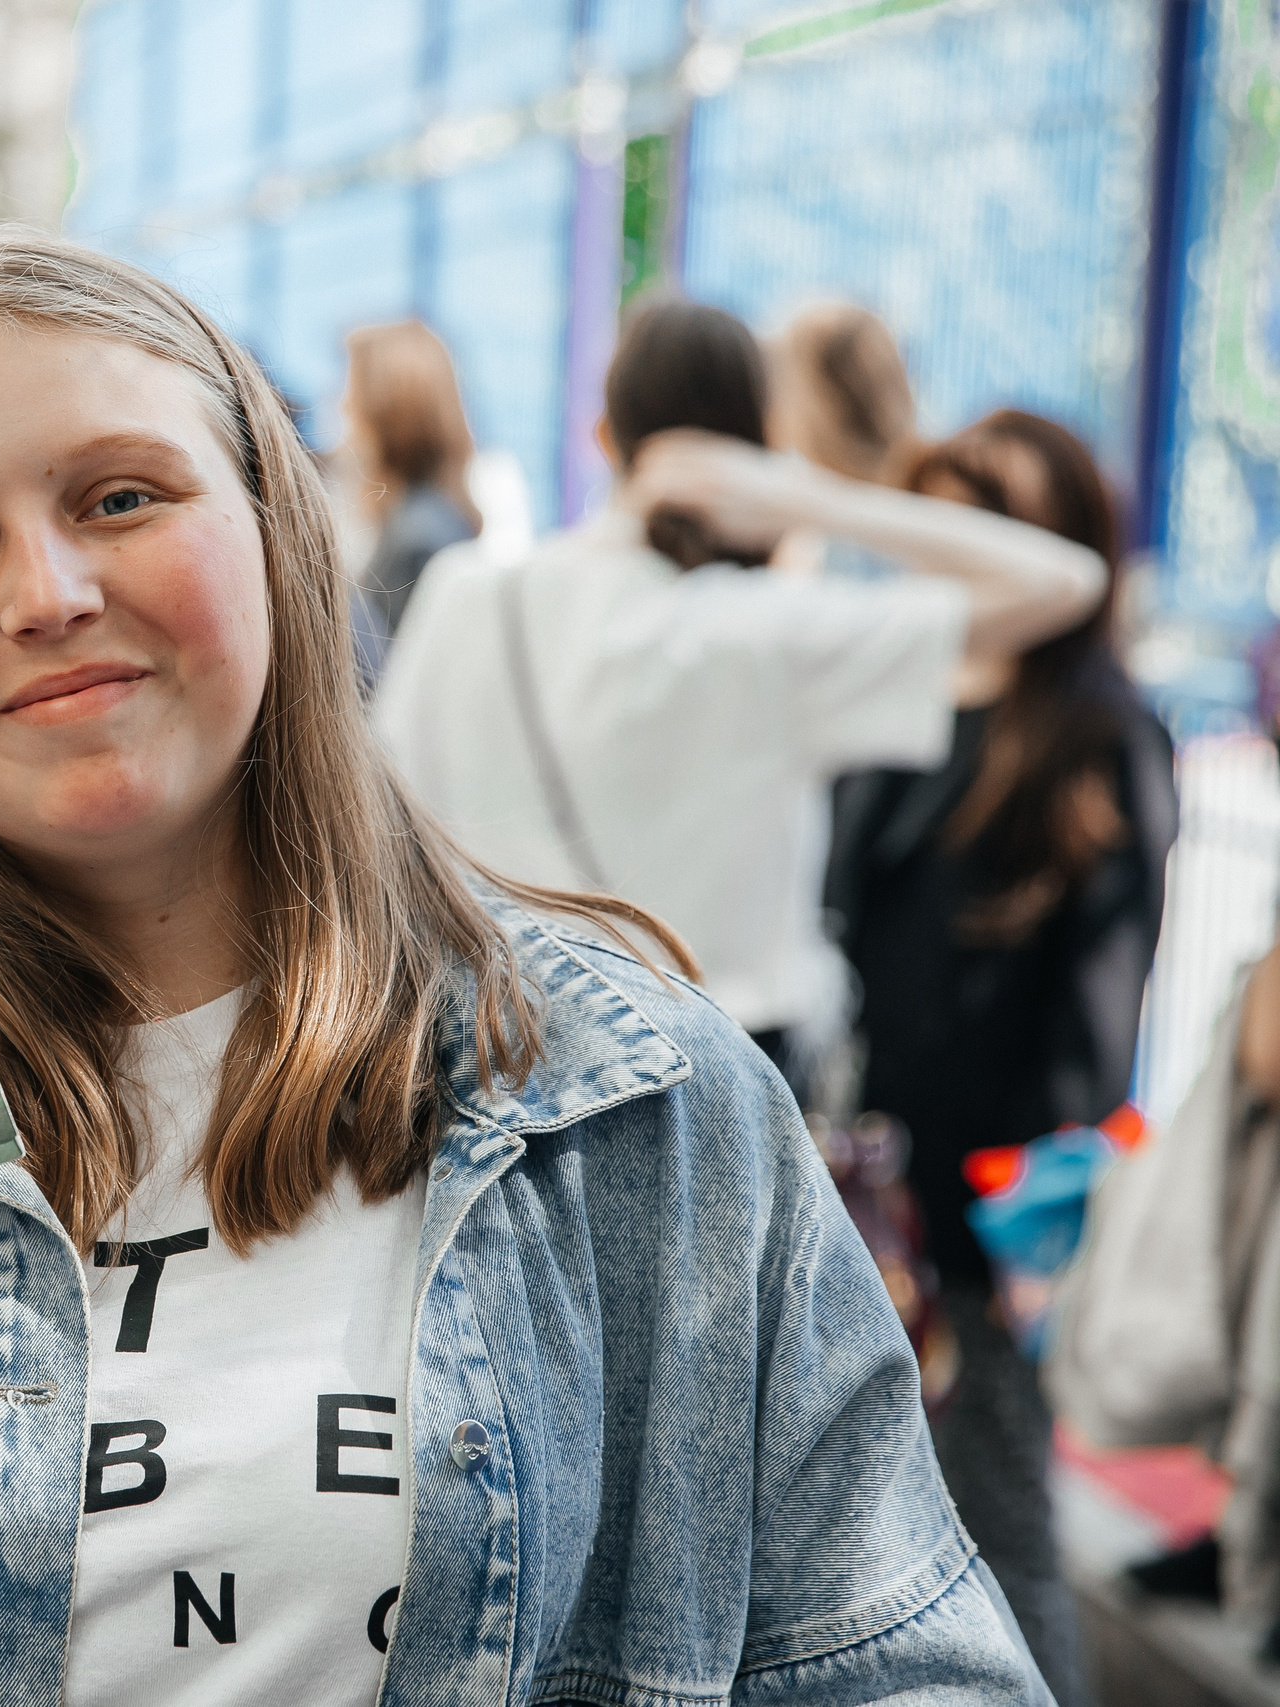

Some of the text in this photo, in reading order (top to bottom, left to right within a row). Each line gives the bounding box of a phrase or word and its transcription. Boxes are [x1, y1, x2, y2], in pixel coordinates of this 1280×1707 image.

[94, 1227, 209, 1352] T
[84, 1393, 401, 1514] B E
[173, 1570, 237, 1648] N
